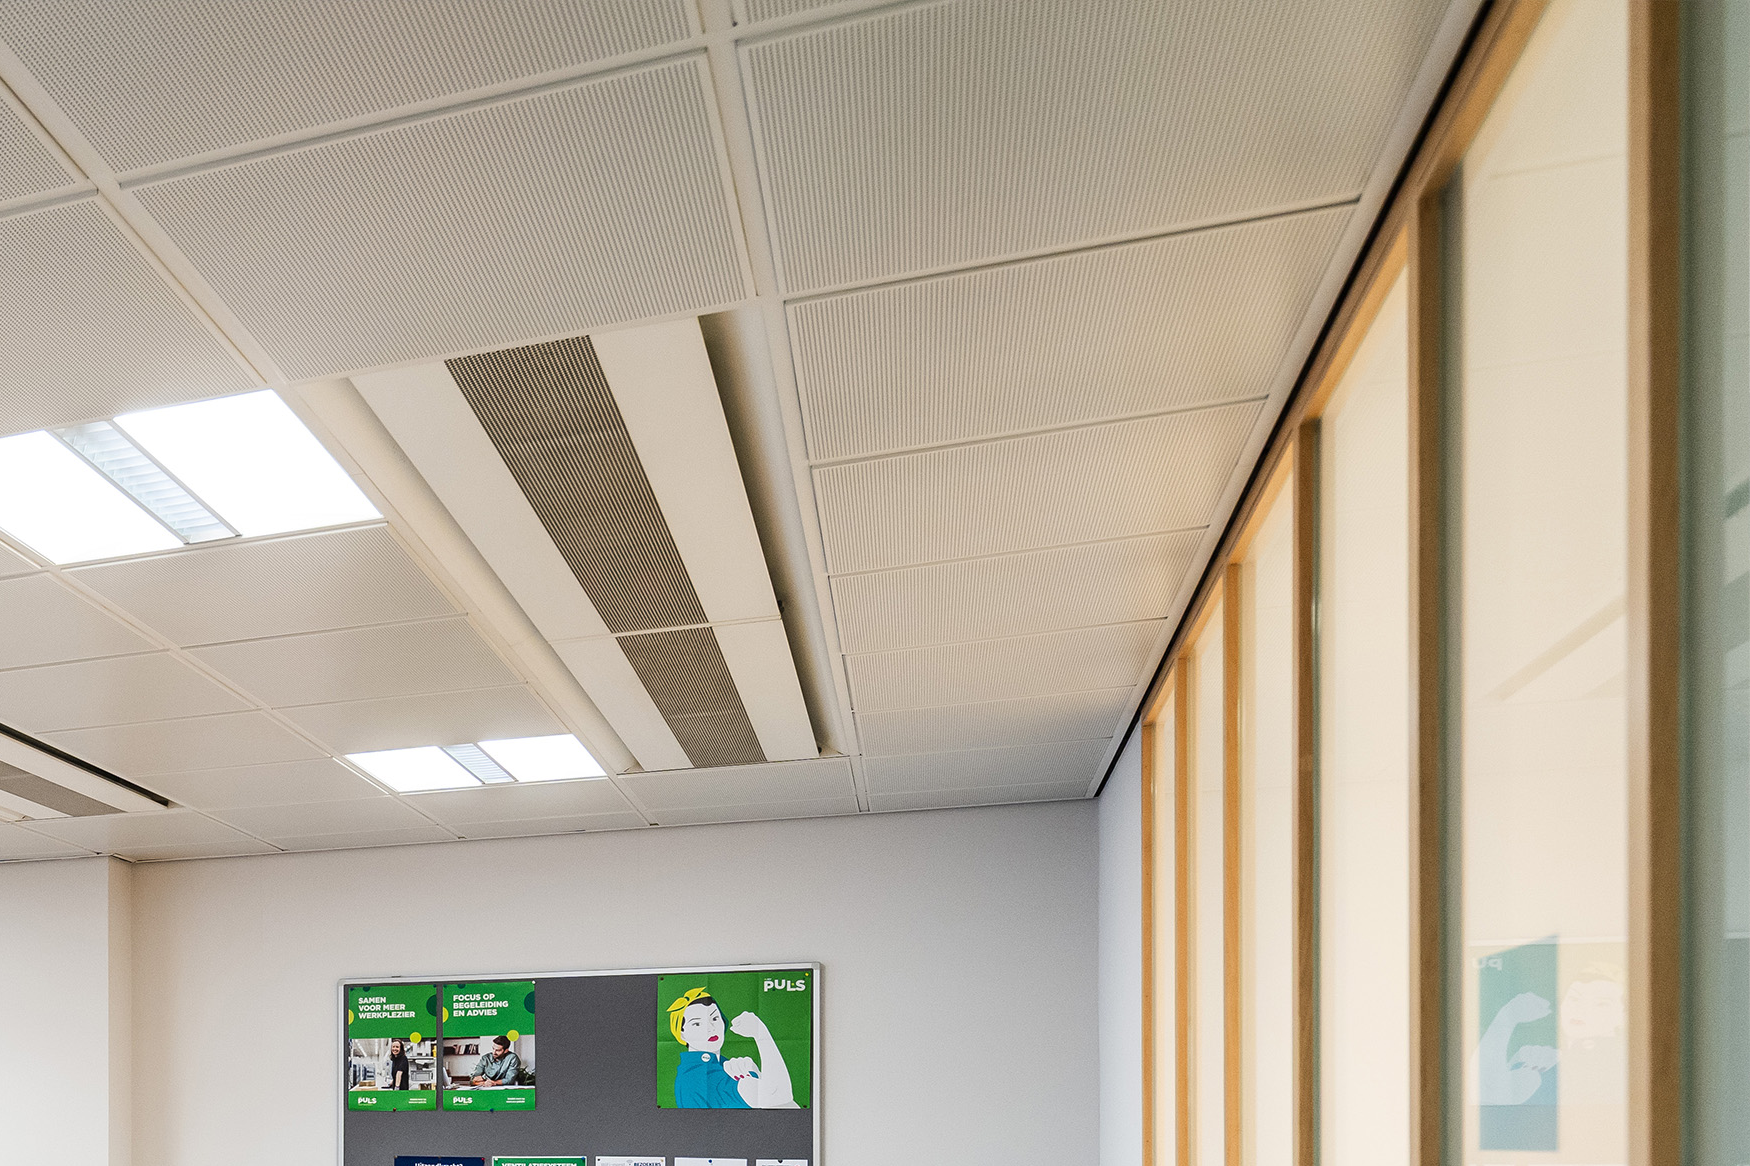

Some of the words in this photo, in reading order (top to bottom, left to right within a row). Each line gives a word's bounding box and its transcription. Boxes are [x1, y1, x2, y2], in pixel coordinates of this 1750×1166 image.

[764, 979, 806, 992] PULS
[453, 994, 481, 1002] FOCUS
[453, 1000, 508, 1010] BEGELEIDING
[358, 1011, 416, 1019] WERKPLEZIER
[467, 1008, 498, 1016] ADVIES
